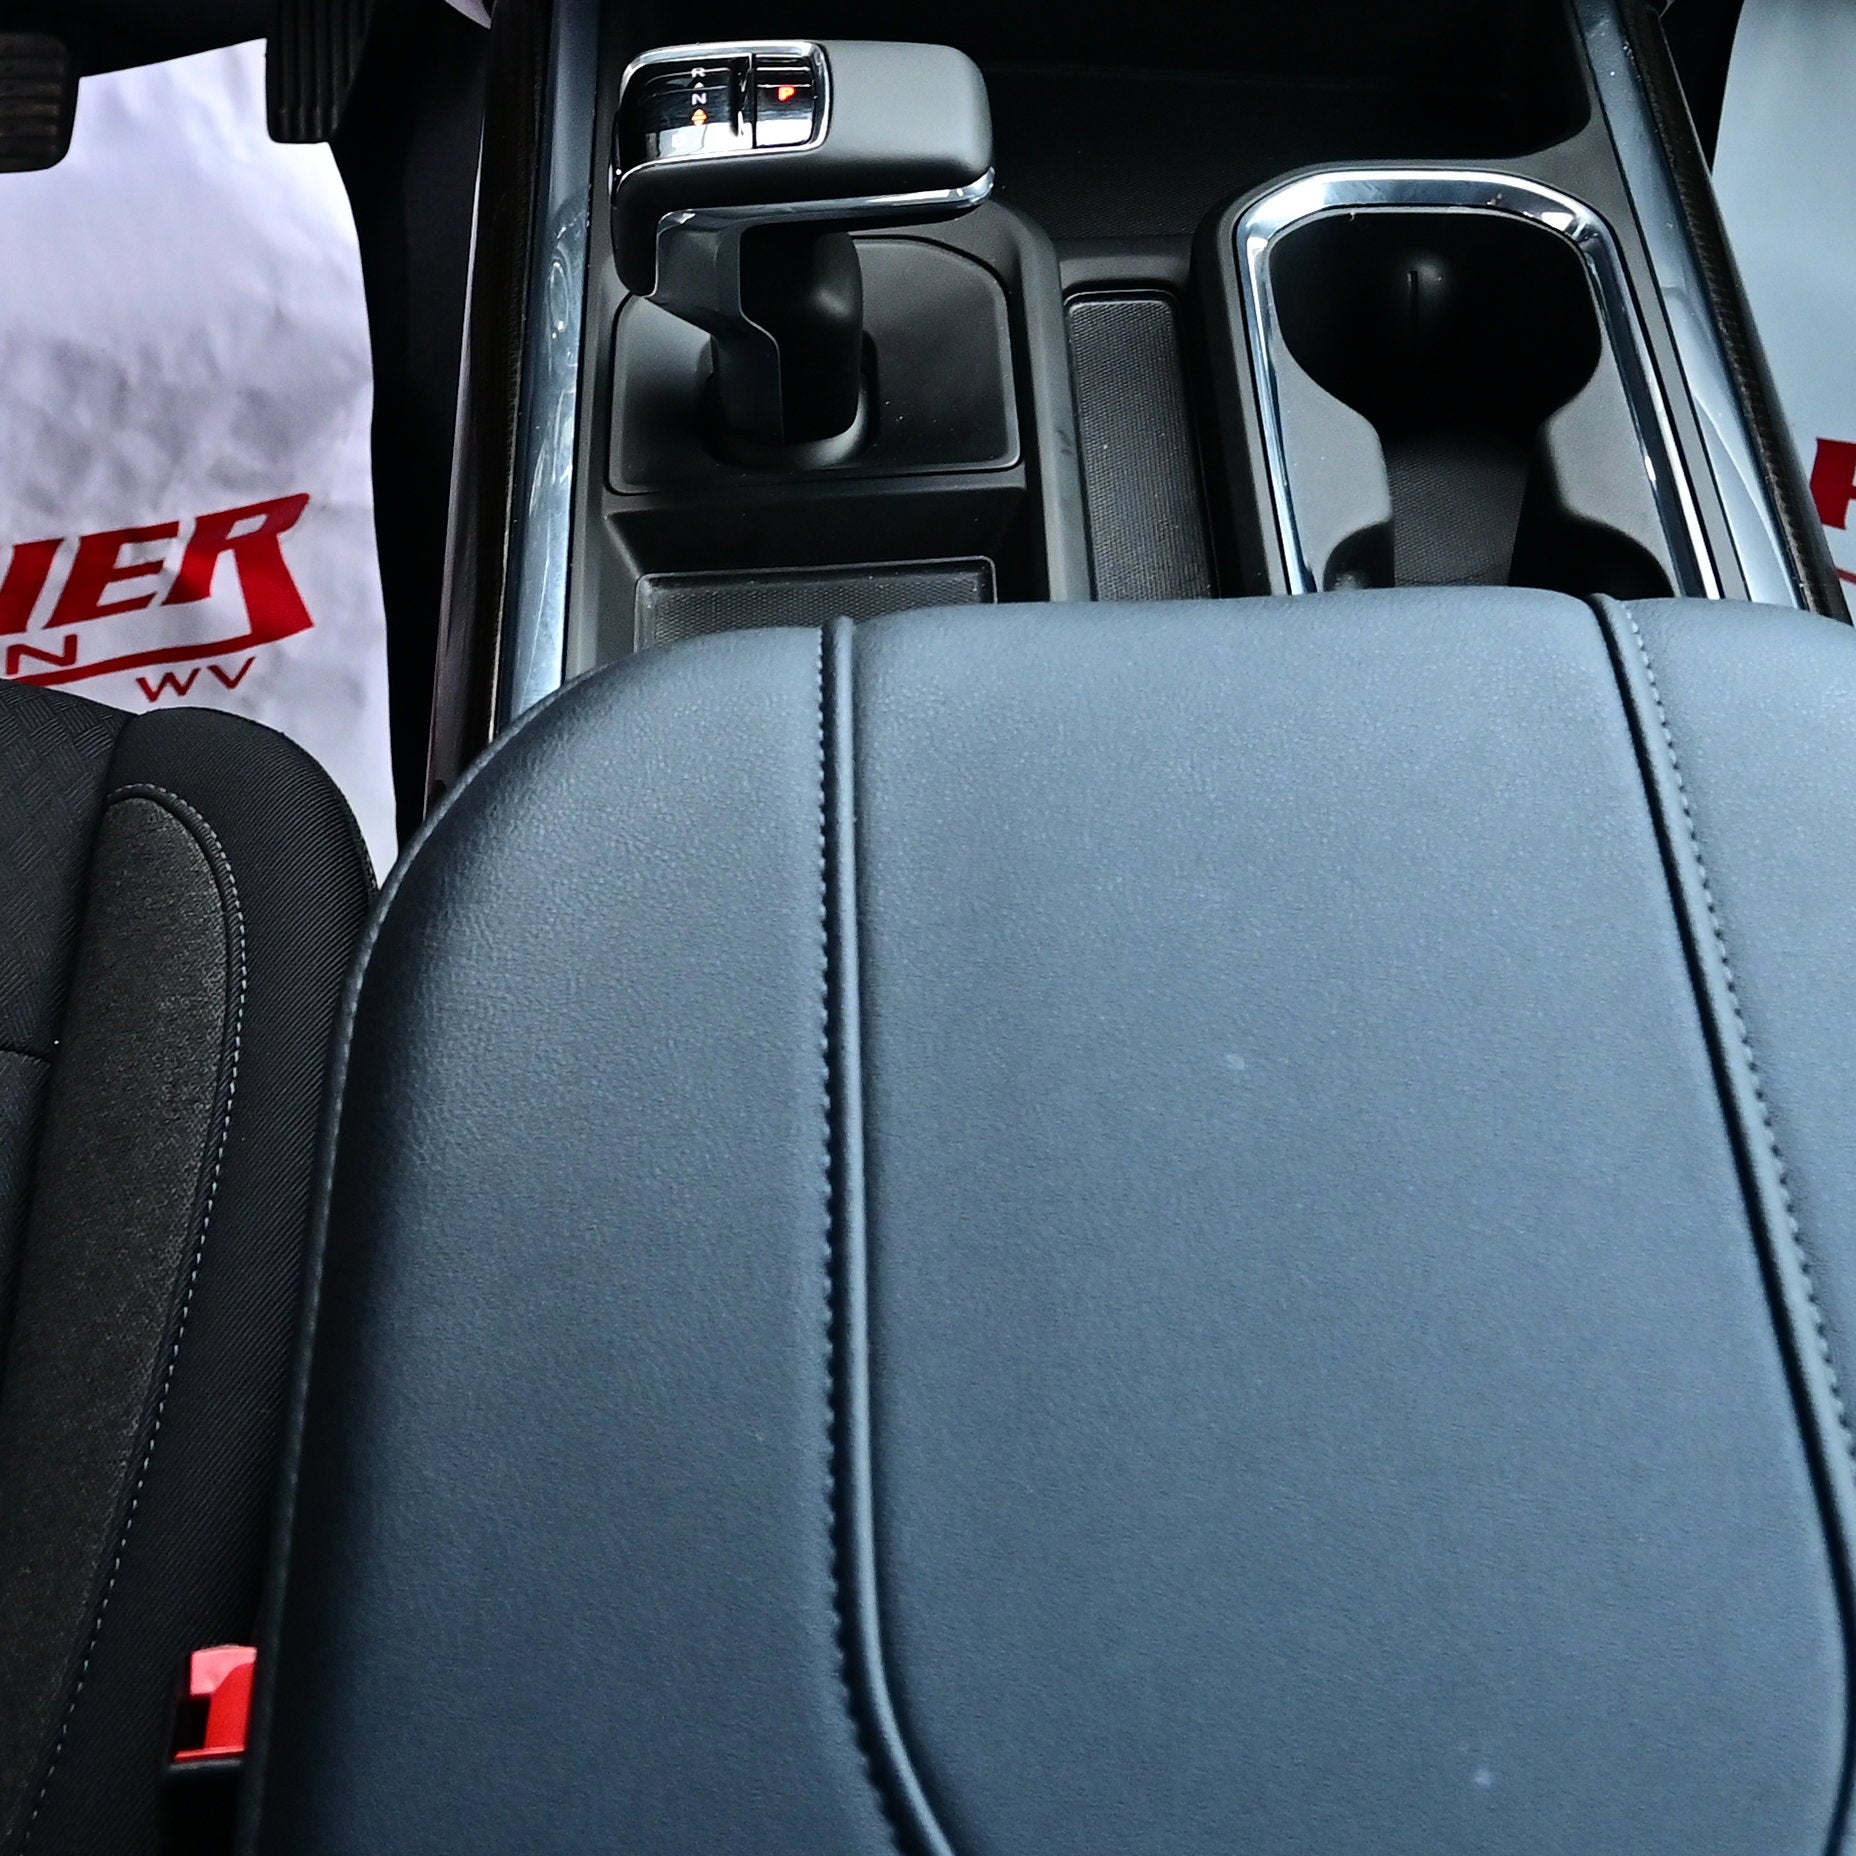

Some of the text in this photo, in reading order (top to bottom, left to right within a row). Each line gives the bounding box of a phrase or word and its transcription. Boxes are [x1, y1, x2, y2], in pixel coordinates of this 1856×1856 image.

[691, 67, 706, 78] R
[691, 92, 707, 106] N
[778, 85, 795, 101] P
[136, 656, 256, 702] WV
